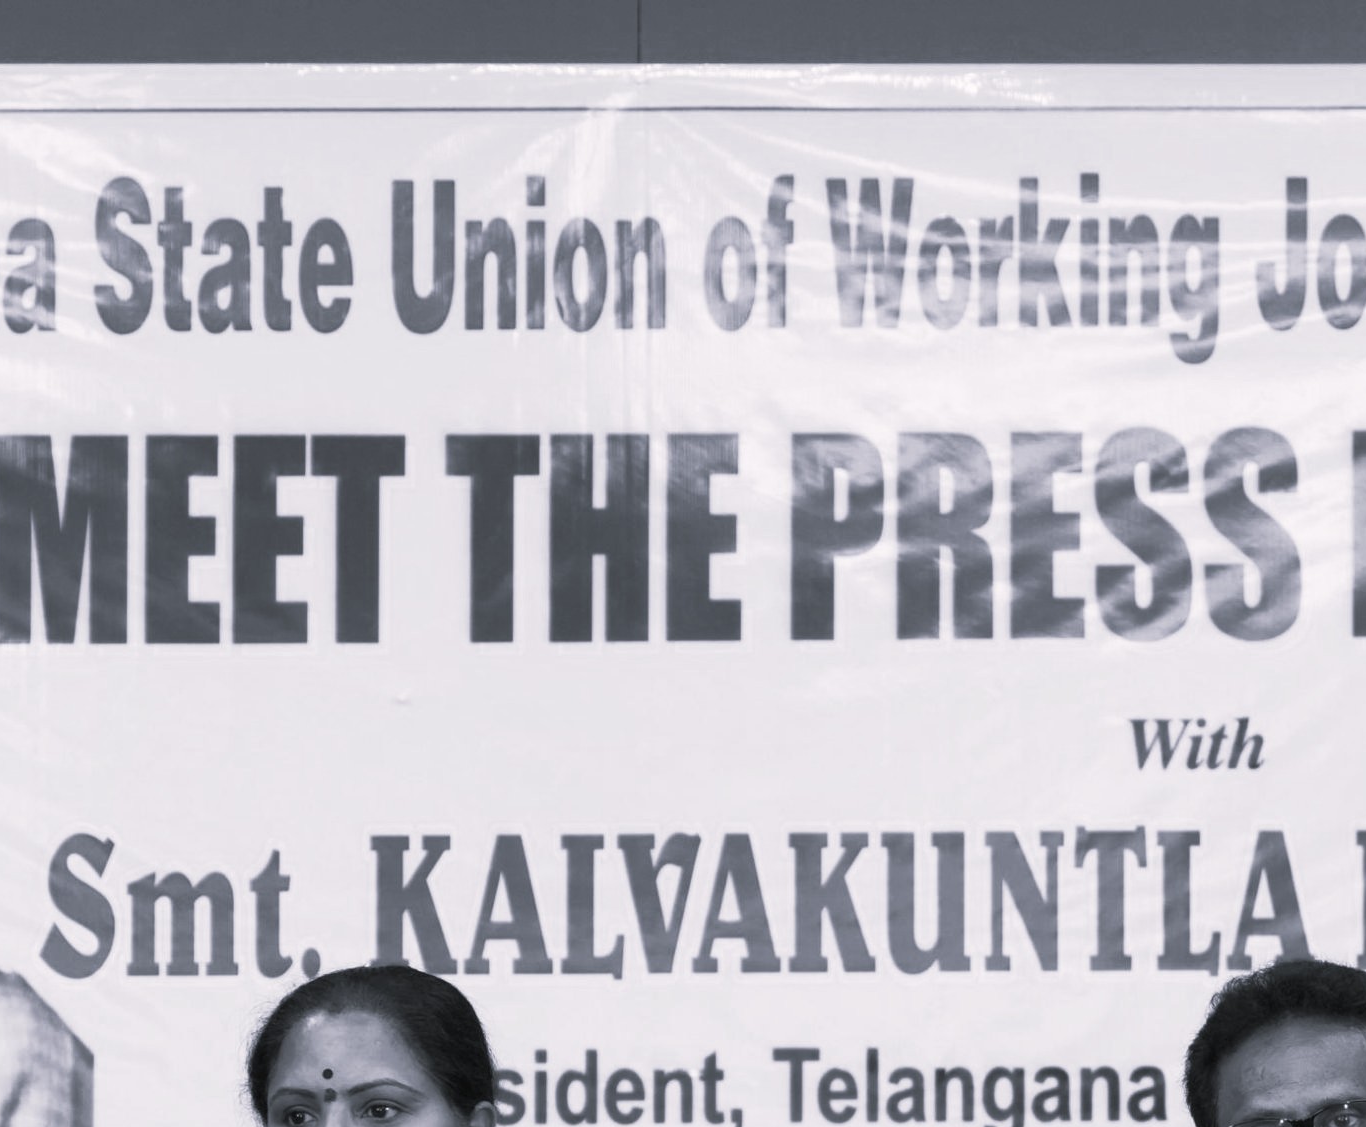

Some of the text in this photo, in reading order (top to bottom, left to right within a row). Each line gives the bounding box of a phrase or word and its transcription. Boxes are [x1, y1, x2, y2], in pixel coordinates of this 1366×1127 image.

[93, 176, 354, 336] State
[391, 175, 667, 335] Union
[703, 173, 795, 332] of
[824, 171, 1220, 365] Working
[445, 433, 742, 644] THE
[790, 426, 1303, 643] PRESS
[1129, 716, 1265, 770] With
[39, 832, 322, 980] Smt.
[369, 825, 1309, 978] KALVAKUNTLA
